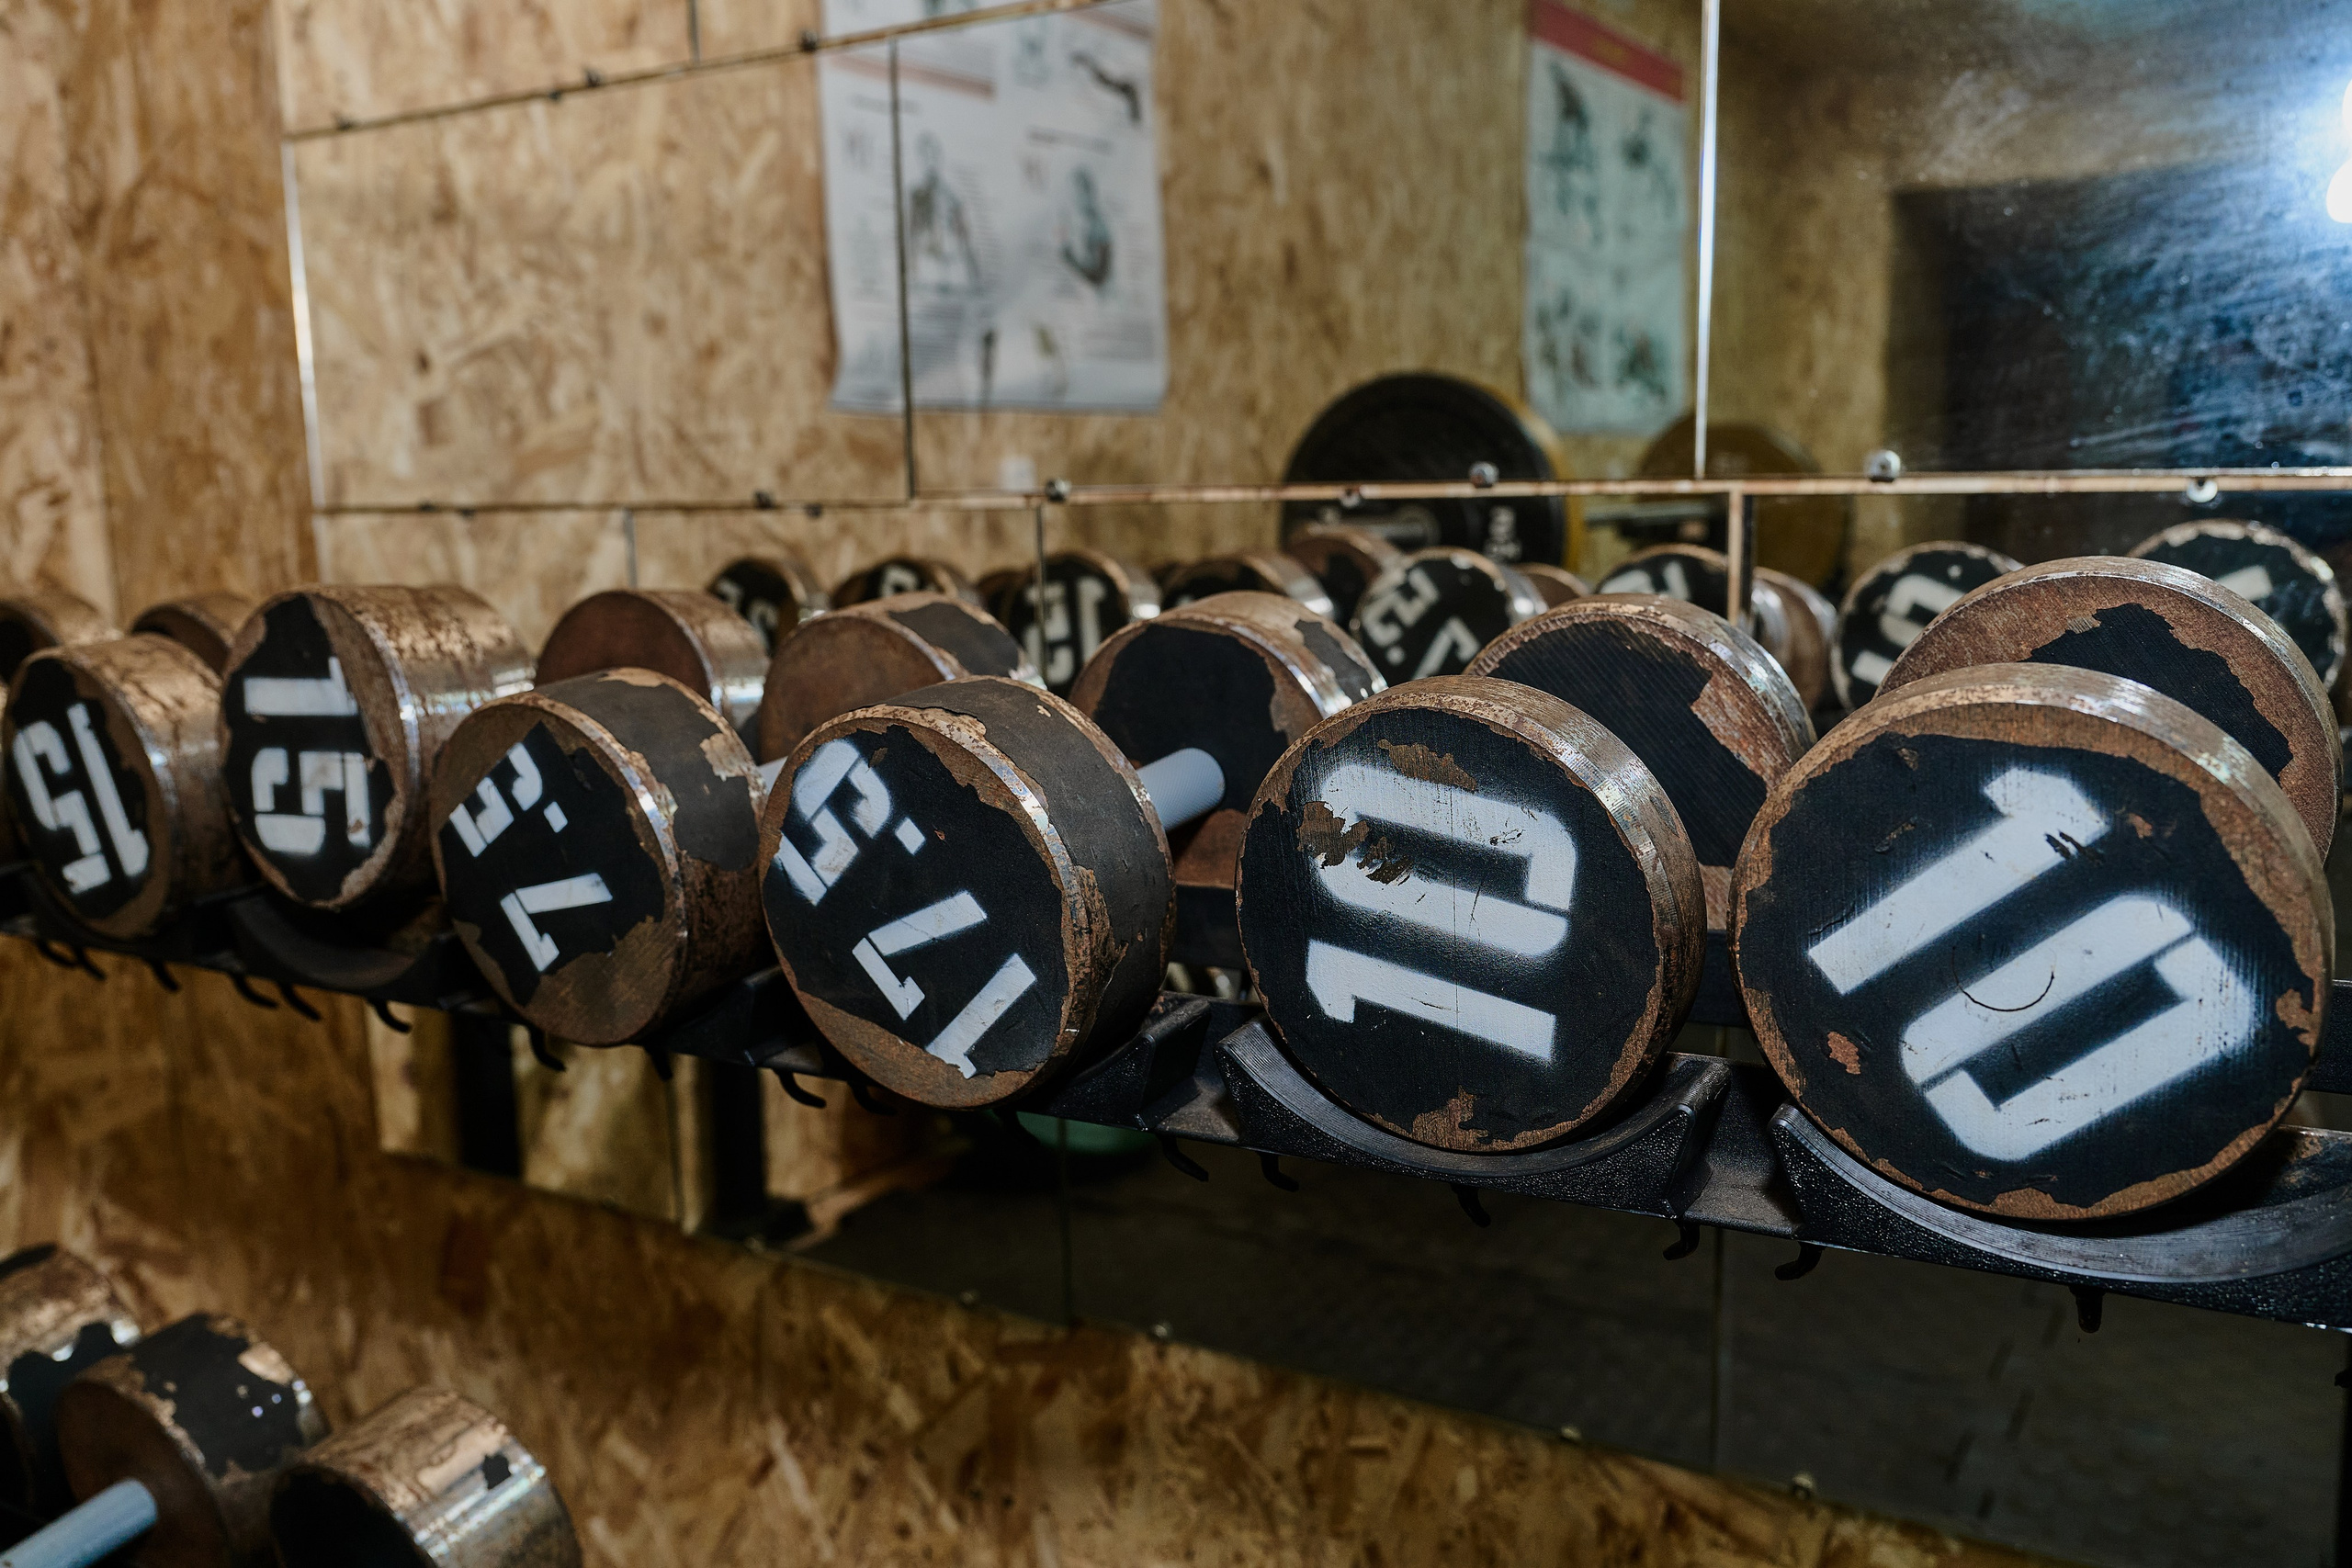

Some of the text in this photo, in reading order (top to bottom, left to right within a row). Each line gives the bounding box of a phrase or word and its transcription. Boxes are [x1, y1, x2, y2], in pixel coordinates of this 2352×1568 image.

[12, 703, 150, 896] 15
[243, 656, 371, 855] 15
[775, 738, 1036, 1078] 17.5
[1305, 761, 1577, 1063] 10
[1807, 766, 2256, 1161] 10
